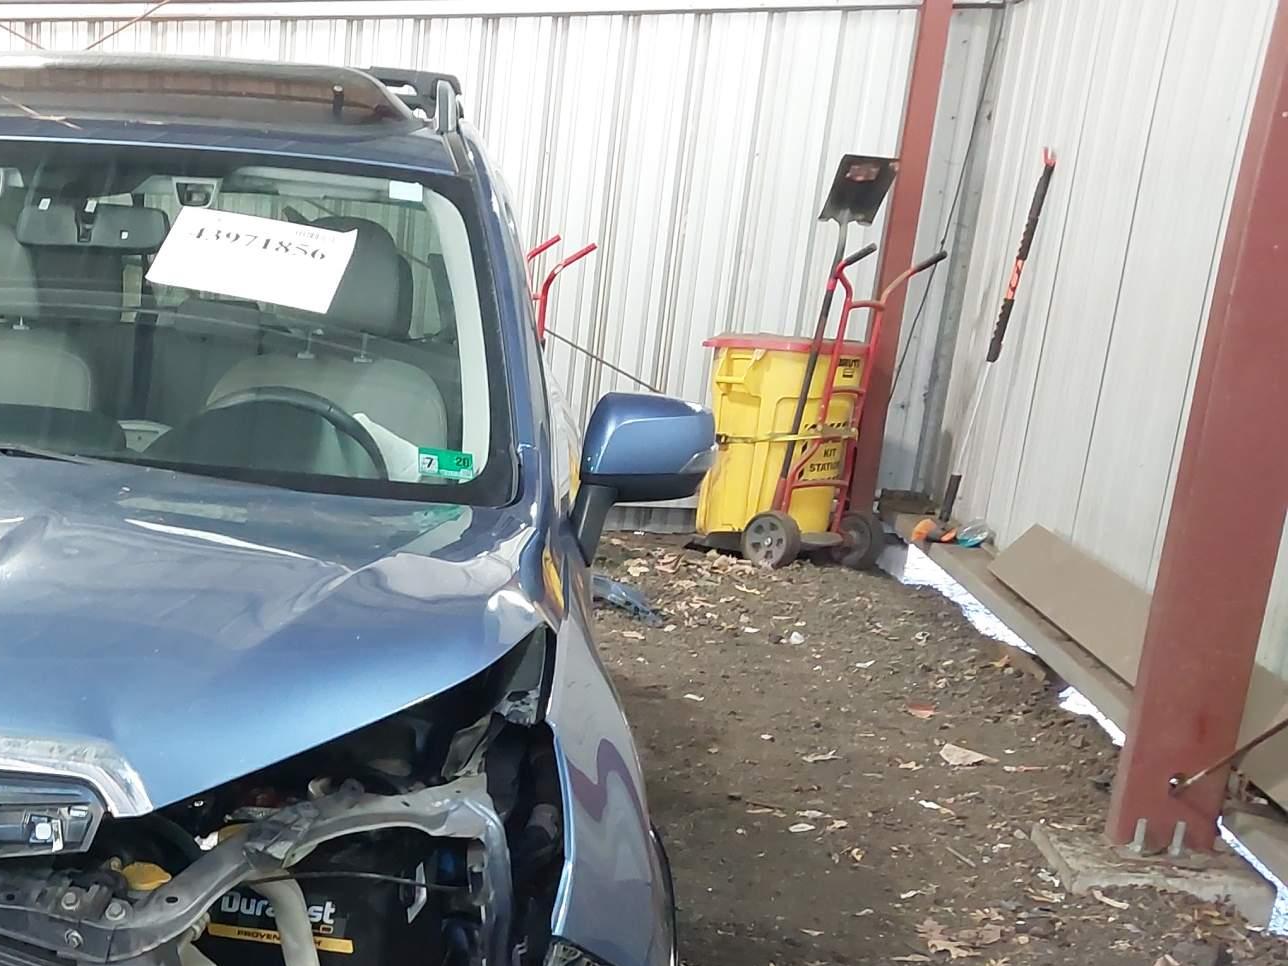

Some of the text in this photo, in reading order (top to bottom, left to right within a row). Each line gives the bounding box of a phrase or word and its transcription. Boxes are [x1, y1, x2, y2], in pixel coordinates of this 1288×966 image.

[823, 448, 837, 457] KIT
[425, 457, 434, 468] 7
[221, 891, 336, 924] Durast
